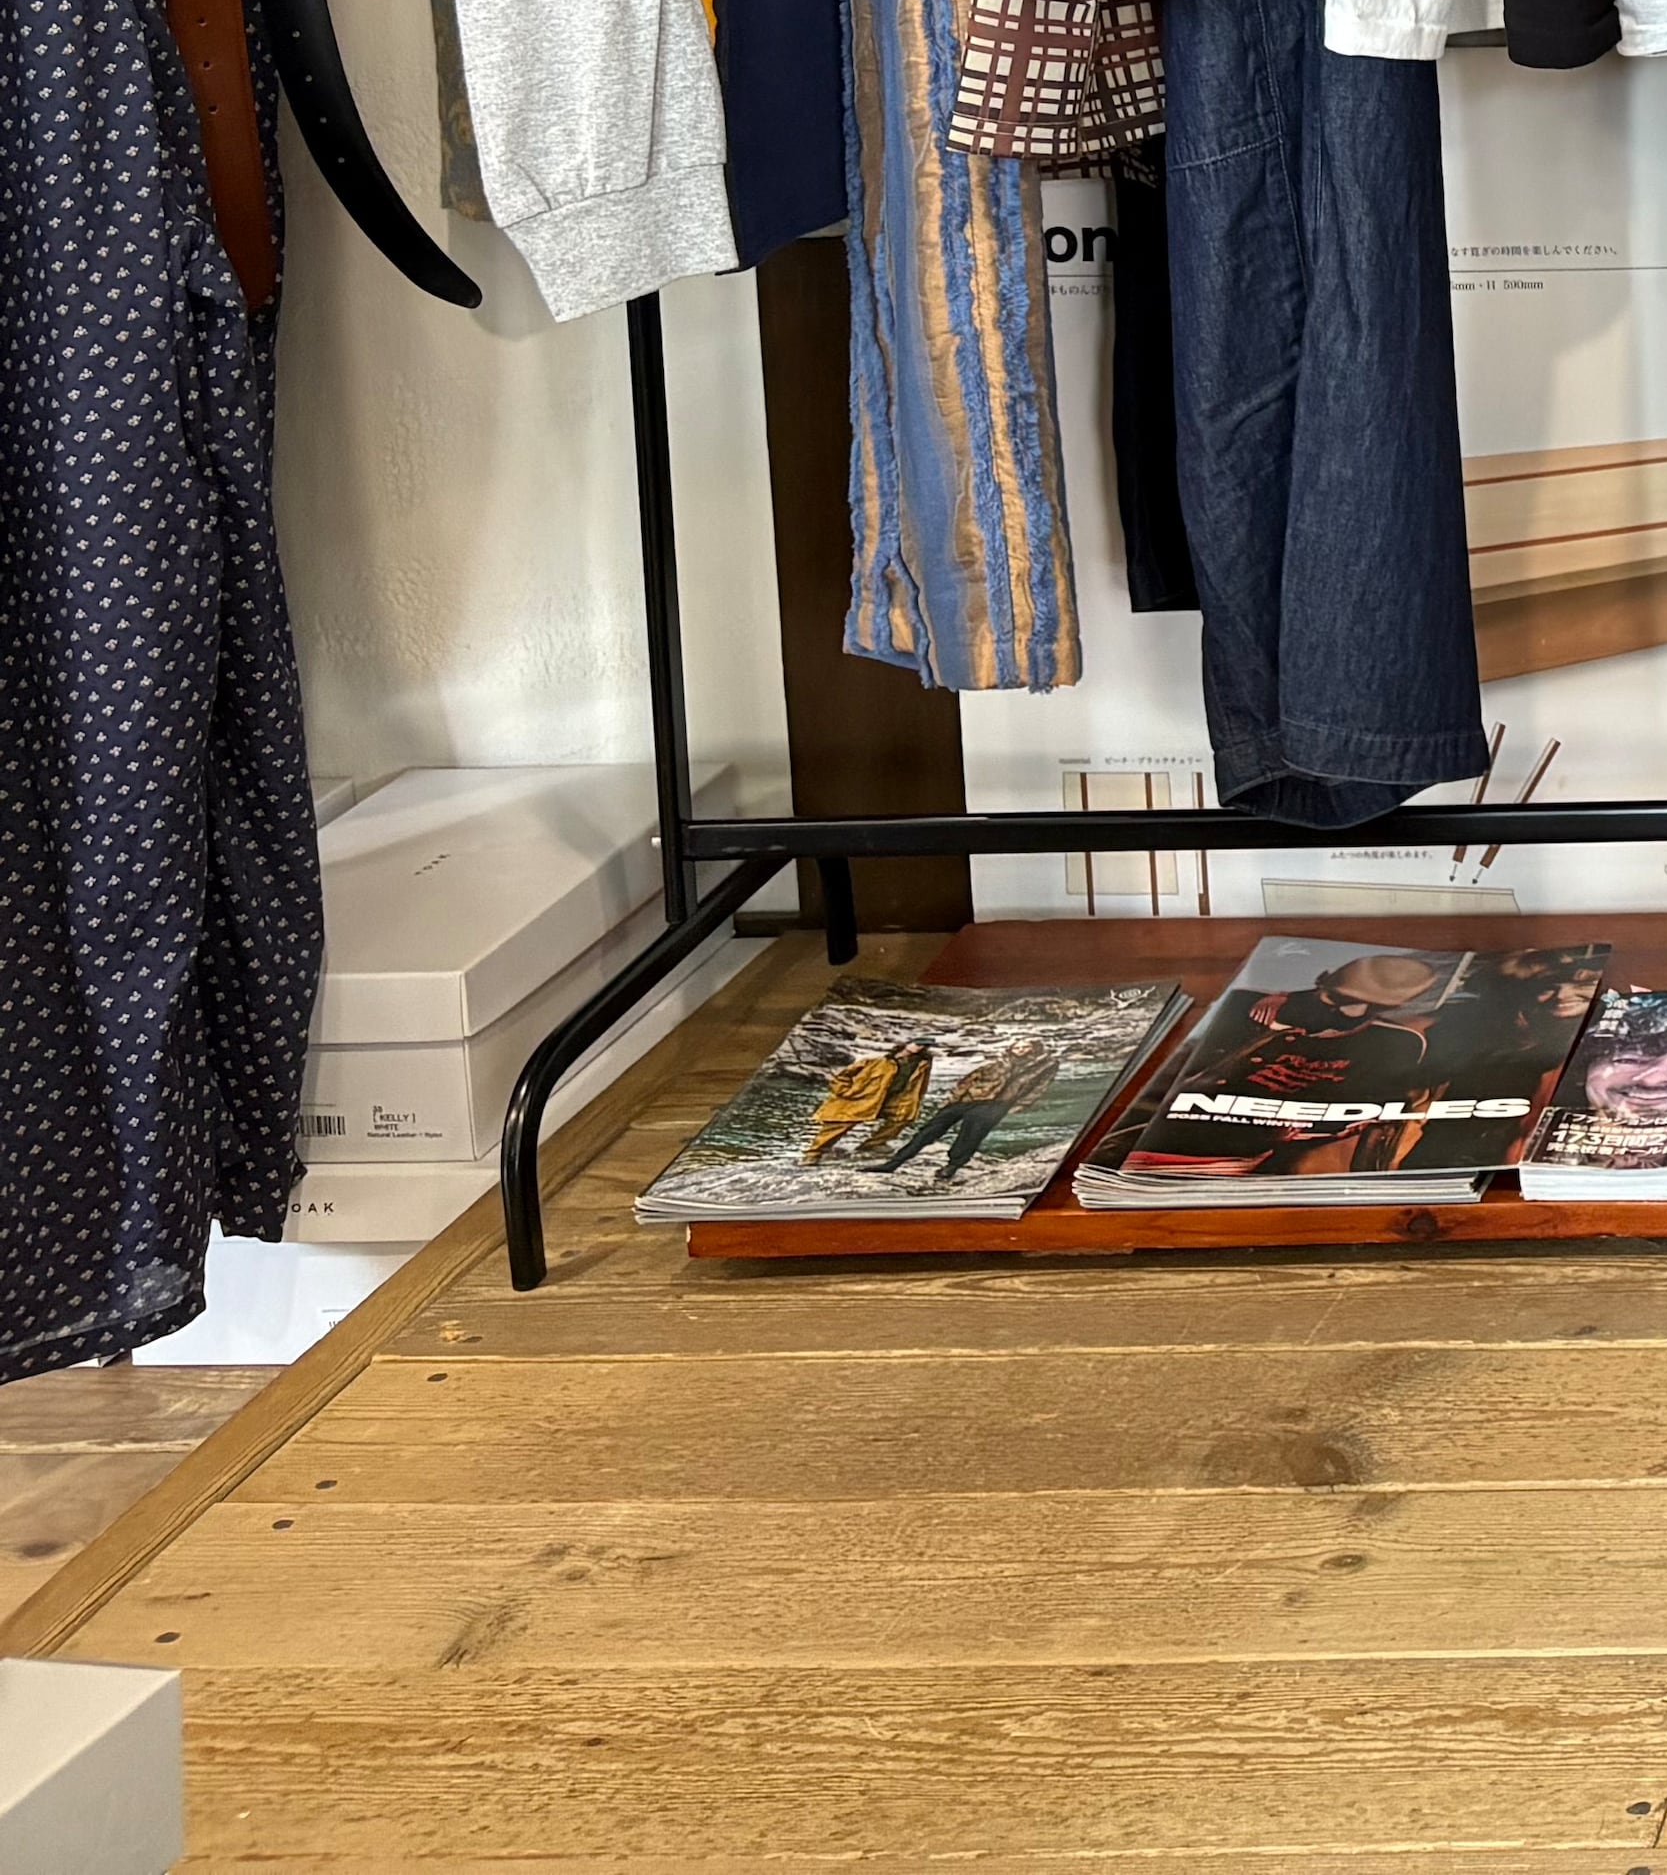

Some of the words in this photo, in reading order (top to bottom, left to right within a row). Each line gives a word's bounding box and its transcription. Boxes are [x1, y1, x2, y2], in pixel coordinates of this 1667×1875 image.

[1170, 1092, 1531, 1122] NEEDLES
[379, 1114, 409, 1122] KELLY
[291, 1202, 334, 1213] OAK
